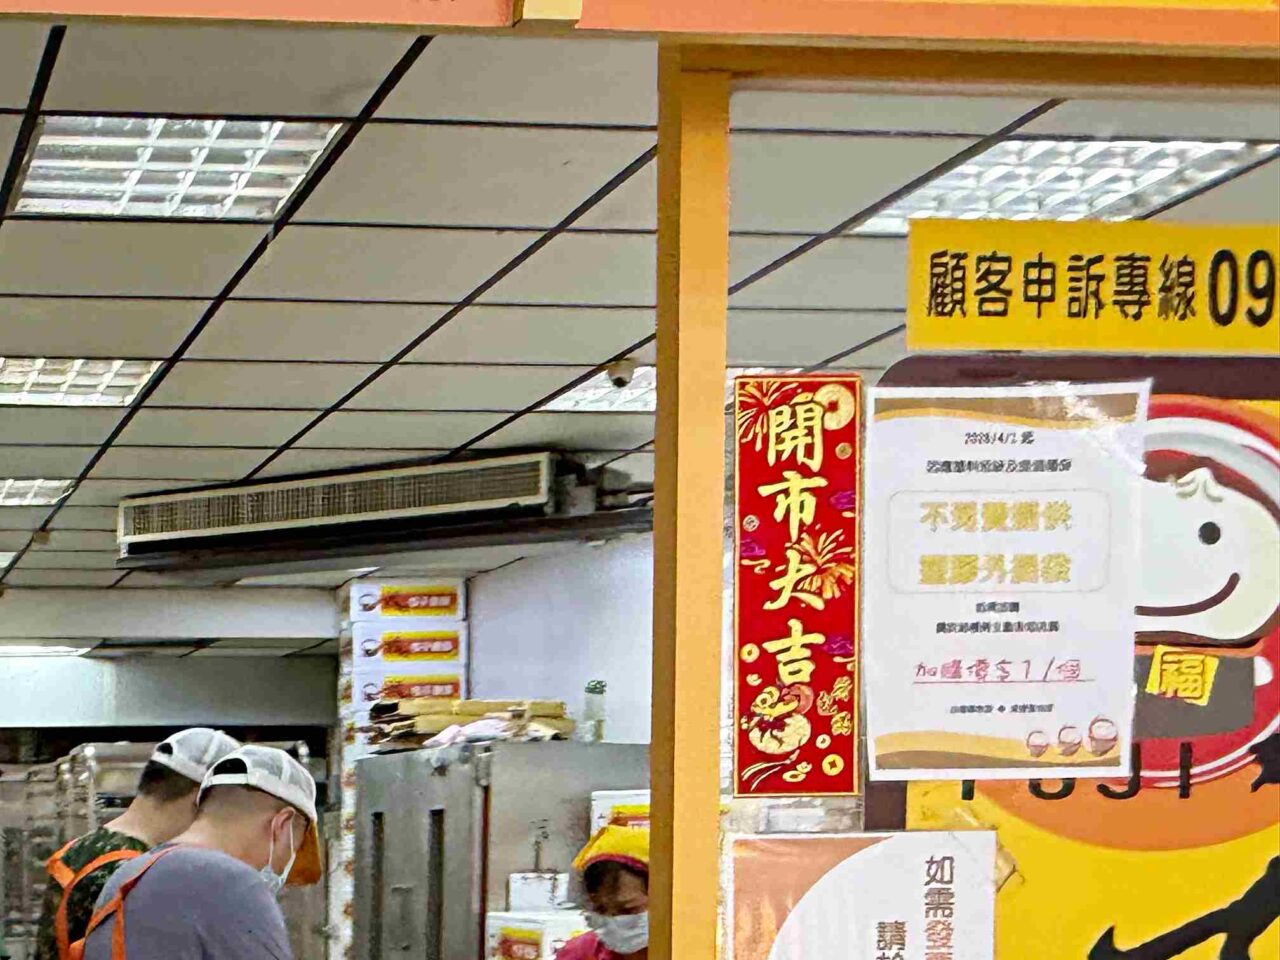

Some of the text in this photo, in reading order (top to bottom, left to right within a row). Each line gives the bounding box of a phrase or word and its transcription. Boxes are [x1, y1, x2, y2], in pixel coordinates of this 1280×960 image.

[926, 249, 1275, 327] 顧客申訴專線09
[757, 401, 829, 686] 開市大吉
